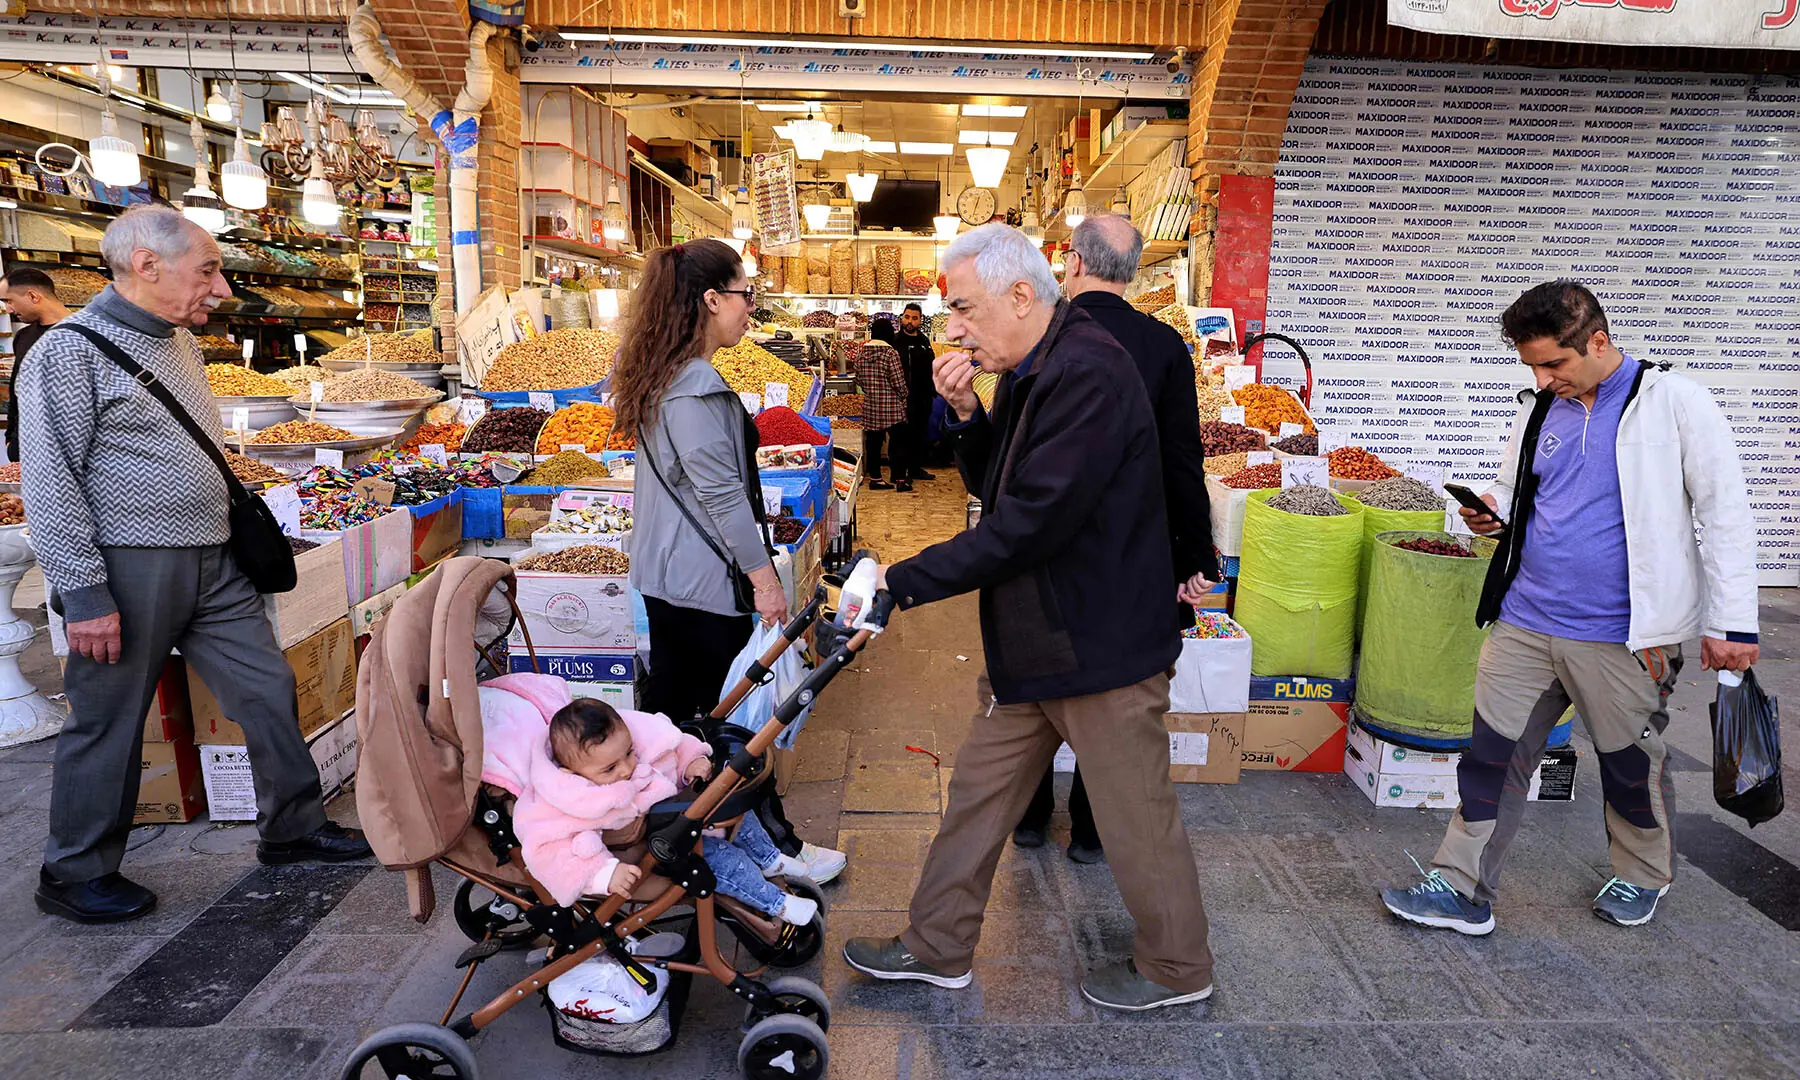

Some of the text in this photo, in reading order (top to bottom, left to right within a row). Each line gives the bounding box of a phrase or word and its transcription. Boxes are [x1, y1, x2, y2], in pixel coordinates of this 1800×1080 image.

[538, 40, 565, 49] LTEC
[604, 42, 641, 51] ALTEC
[680, 43, 718, 52] ALTEC
[756, 46, 794, 55] ALTEC
[577, 56, 614, 67] ALTEC
[652, 58, 690, 69] ALTEC
[803, 61, 840, 73] ALTEC
[877, 63, 915, 75] ALTEC
[952, 66, 989, 77] ALTEC
[1025, 68, 1062, 79] ALTEC
[1100, 70, 1135, 81] ALTEC
[1328, 65, 1609, 84] MAXIDOOR MAXIDOOR MAXIDOOR MAXIDOOR
[1367, 82, 1721, 102] MAXIDOOR MAXIDOOR MAXIDOOR MAXIDOOR MAXIDOOR
[1366, 97, 1796, 119] MAXIDOOR MAXIDOOR MAXIDOOR MAXIDOOR MAXIDOOR
[1433, 115, 1634, 129] MAXIDOOR MAXIDOOR MAXIDOOR
[1354, 127, 1705, 147] MAXIDOOR MAXIDOOR MAXIDOOR MAXIDOOR MAXIDOOR
[1325, 141, 1676, 161] MAXIDOOR MAXIDOOR MAXIDOOR MAXIDOOR
[1353, 157, 1705, 176] MAXIDOOR MAXIDOOR MAXIDOOR MAXIDOOR MAXIDOOR
[1347, 171, 1701, 190] MAXIDOOR MAXIDOOR MAXIDOOR MAXIDOOR
[1326, 183, 1676, 201] MAXIDOOR MAXIDOOR MAXIDOOR MAXIDOOR MAXIDOOR
[1368, 201, 1789, 220] MAXIDOOR MAXIDOOR MAXIDOOR MAXIDOOR MAXIDOOR MAXIDOOR
[1326, 215, 1754, 234] MAXIDOOR MAXIDOOR MAXIDOOR MAXIDOOR MAXIDOOR MAXIDOOR
[1315, 228, 1740, 248] MAXIDOOR MAXIDOOR MAXIDOOR MAXIDOOR MAXIDOOR MAXIDOOR
[1306, 241, 1654, 260] MAXIDOOR MAXIDOOR MAXIDOOR MAXIDOOR
[1344, 257, 1693, 276] MAXIDOOR MAXIDOOR MAXIDOOR MAXIDOOR MAXIDOOR
[1329, 270, 1755, 289] MAXIDOOR MAXIDOOR MAXIDOOR MAXIDOOR
[1366, 284, 1797, 304] MAXIDOOR MAXIDOOR MAXIDOOR
[1298, 296, 1712, 317] MAXIDOOR MAXIDOOR MAXIDOOR MAXIDOOR
[1318, 310, 1730, 329] MAXIDOOR MAXIDOOR MAXIDOOR
[1427, 328, 1691, 343] MAXIDOOR MAXIDOOR
[1322, 352, 1445, 363] MAXIDOOR MAXIDOOR
[1361, 339, 1768, 358] MAXIDOOR MAXIDOOR MAXIDOOR MAXIDOOR
[1317, 378, 1799, 397] MAXIDOOR MAXIDOOR MAXIDOOR MAXIDOOR
[1323, 391, 1799, 410] MAXIDOOR MAXIDOOR MAXIDOOR MAXIDOOR
[1398, 407, 1446, 416] MAXIDOOR
[1361, 418, 1481, 430] MAXIDOOR MAXIDOOR
[1437, 447, 1485, 456] MAXIDOOR
[548, 661, 594, 675] PLUMS
[1275, 683, 1333, 699] PLUMS
[320, 752, 342, 772] ULTRA
